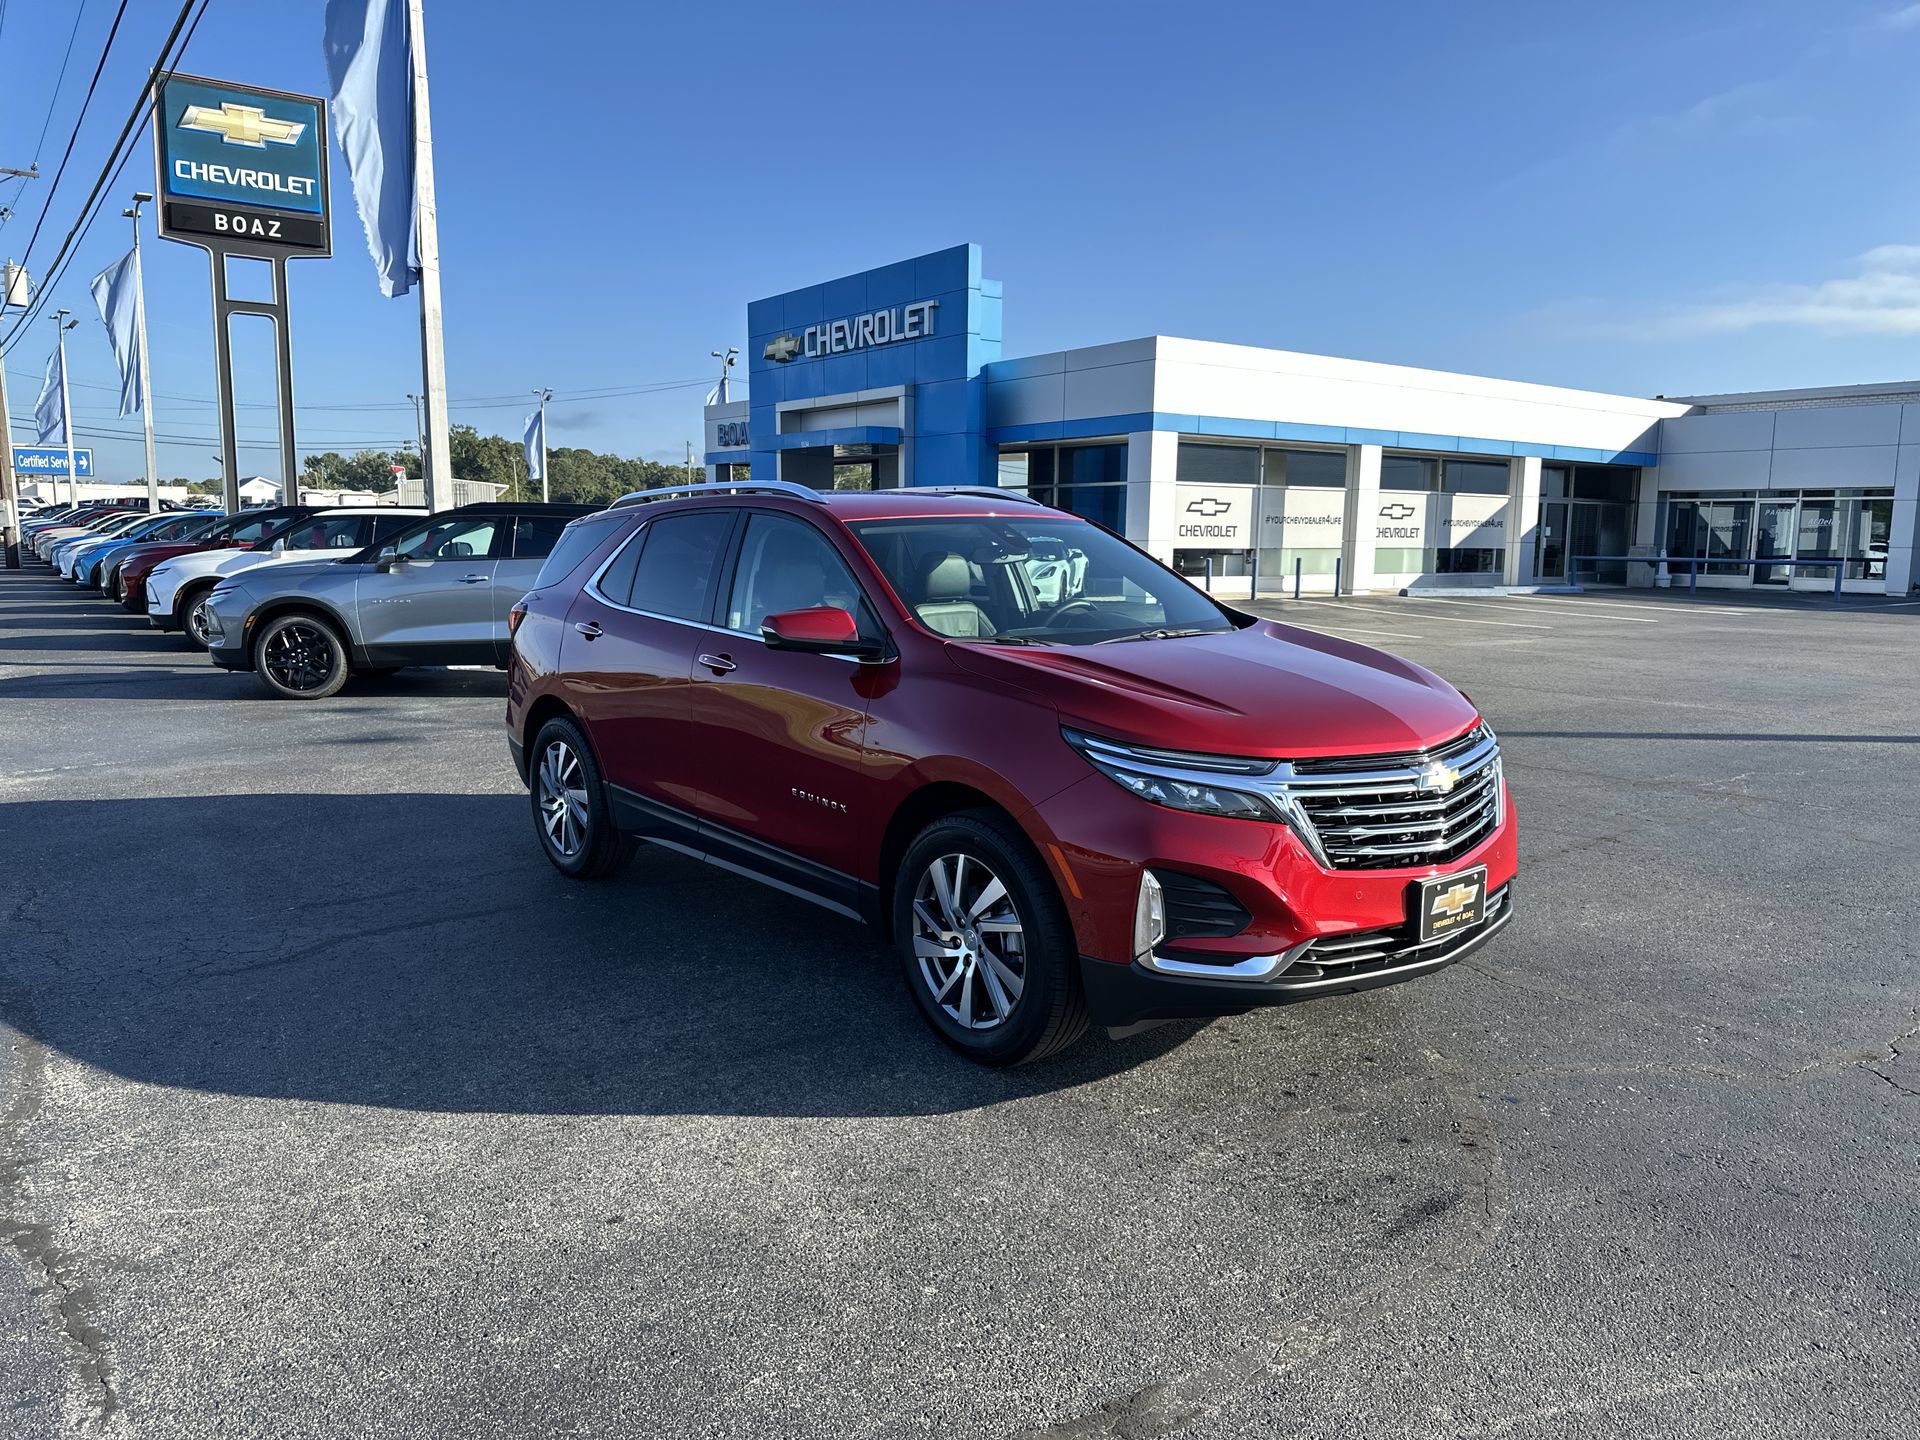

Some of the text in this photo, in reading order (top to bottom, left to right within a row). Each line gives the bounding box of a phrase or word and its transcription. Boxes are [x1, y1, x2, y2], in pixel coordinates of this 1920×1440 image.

[174, 159, 316, 196] CHEVROLET
[214, 213, 282, 238] BOAZ
[804, 300, 938, 358] CHEVROLET
[717, 421, 750, 447] BOA
[18, 454, 77, 469] Certified Servie
[1179, 525, 1238, 537] CHEVROLET
[1265, 515, 1342, 525] #YOURCHEVYDEALER4LIFE
[791, 787, 847, 813] EQUINOX
